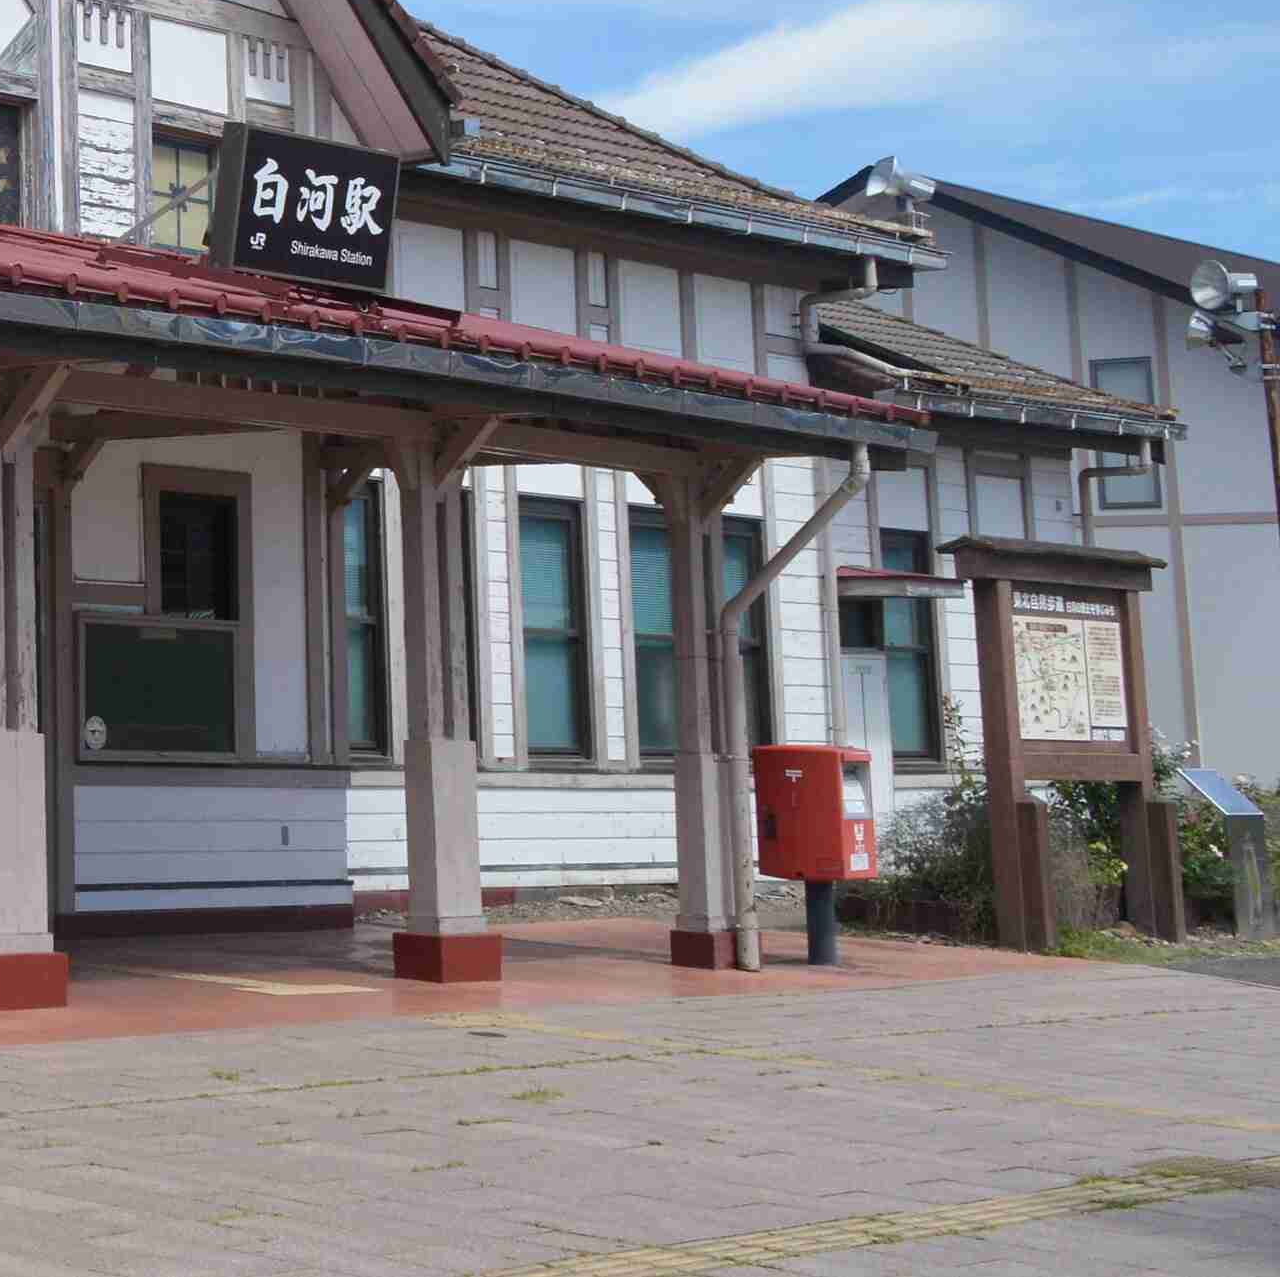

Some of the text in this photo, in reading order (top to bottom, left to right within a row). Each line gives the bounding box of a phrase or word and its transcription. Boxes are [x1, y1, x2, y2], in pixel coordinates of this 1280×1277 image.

[252, 157, 384, 236] 白河駅
[250, 232, 266, 246] JR
[290, 240, 373, 267] Shirakawa Station
